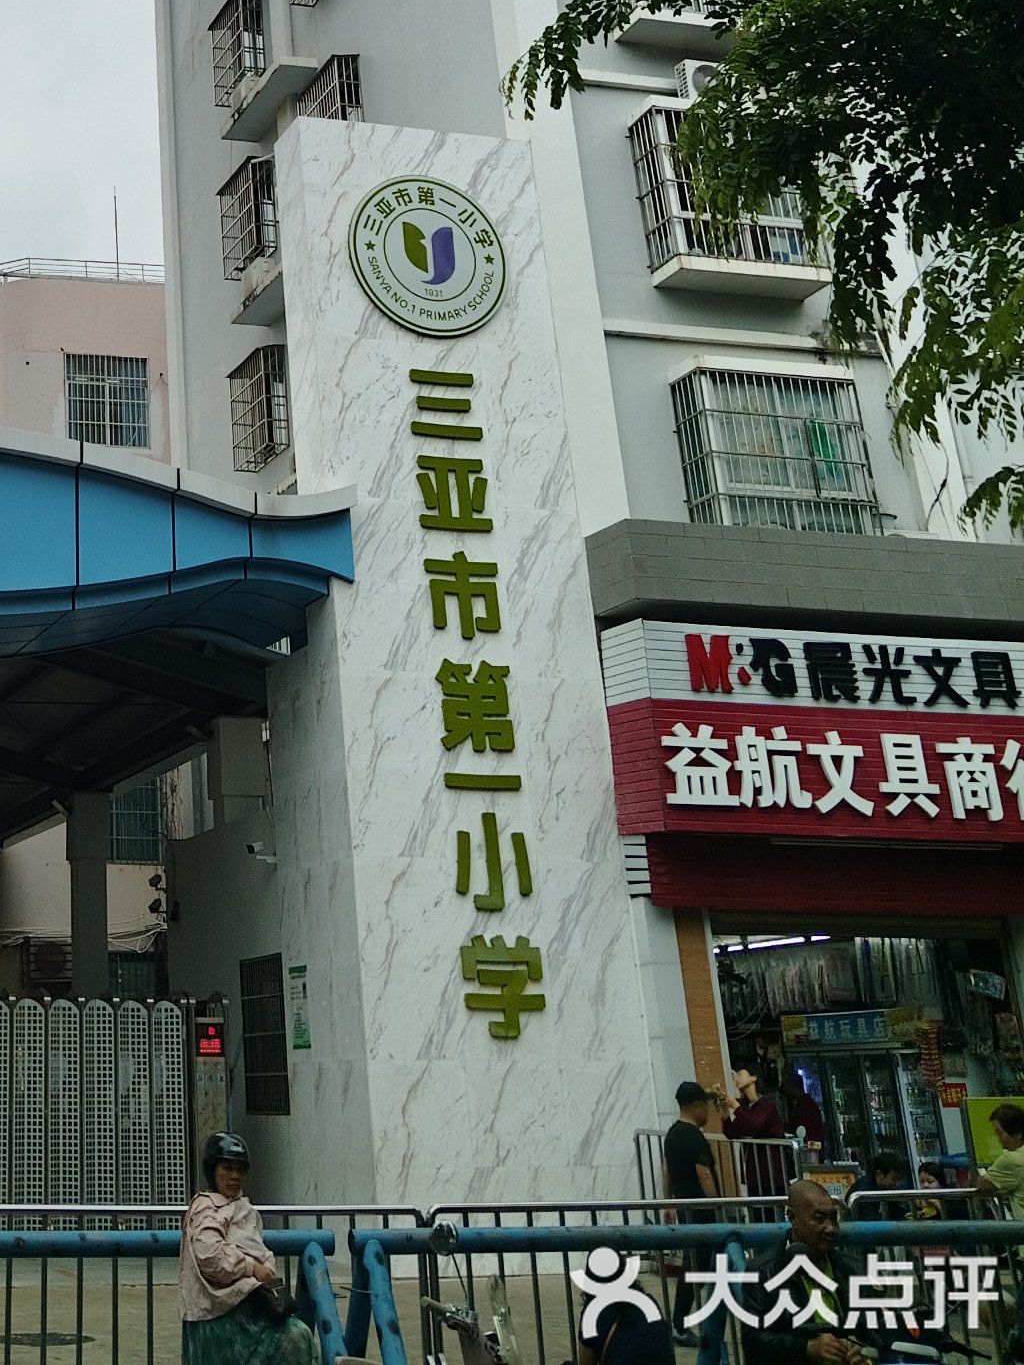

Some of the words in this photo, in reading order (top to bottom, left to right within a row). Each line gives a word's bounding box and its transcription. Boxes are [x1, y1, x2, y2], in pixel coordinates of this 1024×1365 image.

[363, 185, 494, 248] 三亚市第一小学
[367, 255, 393, 294] SANYA
[391, 291, 416, 314] NO.1
[419, 306, 468, 322] PRIMARY
[467, 271, 494, 311] SCHOOL
[424, 288, 444, 298] 1931
[409, 368, 546, 1038] 三亚市第一小学
